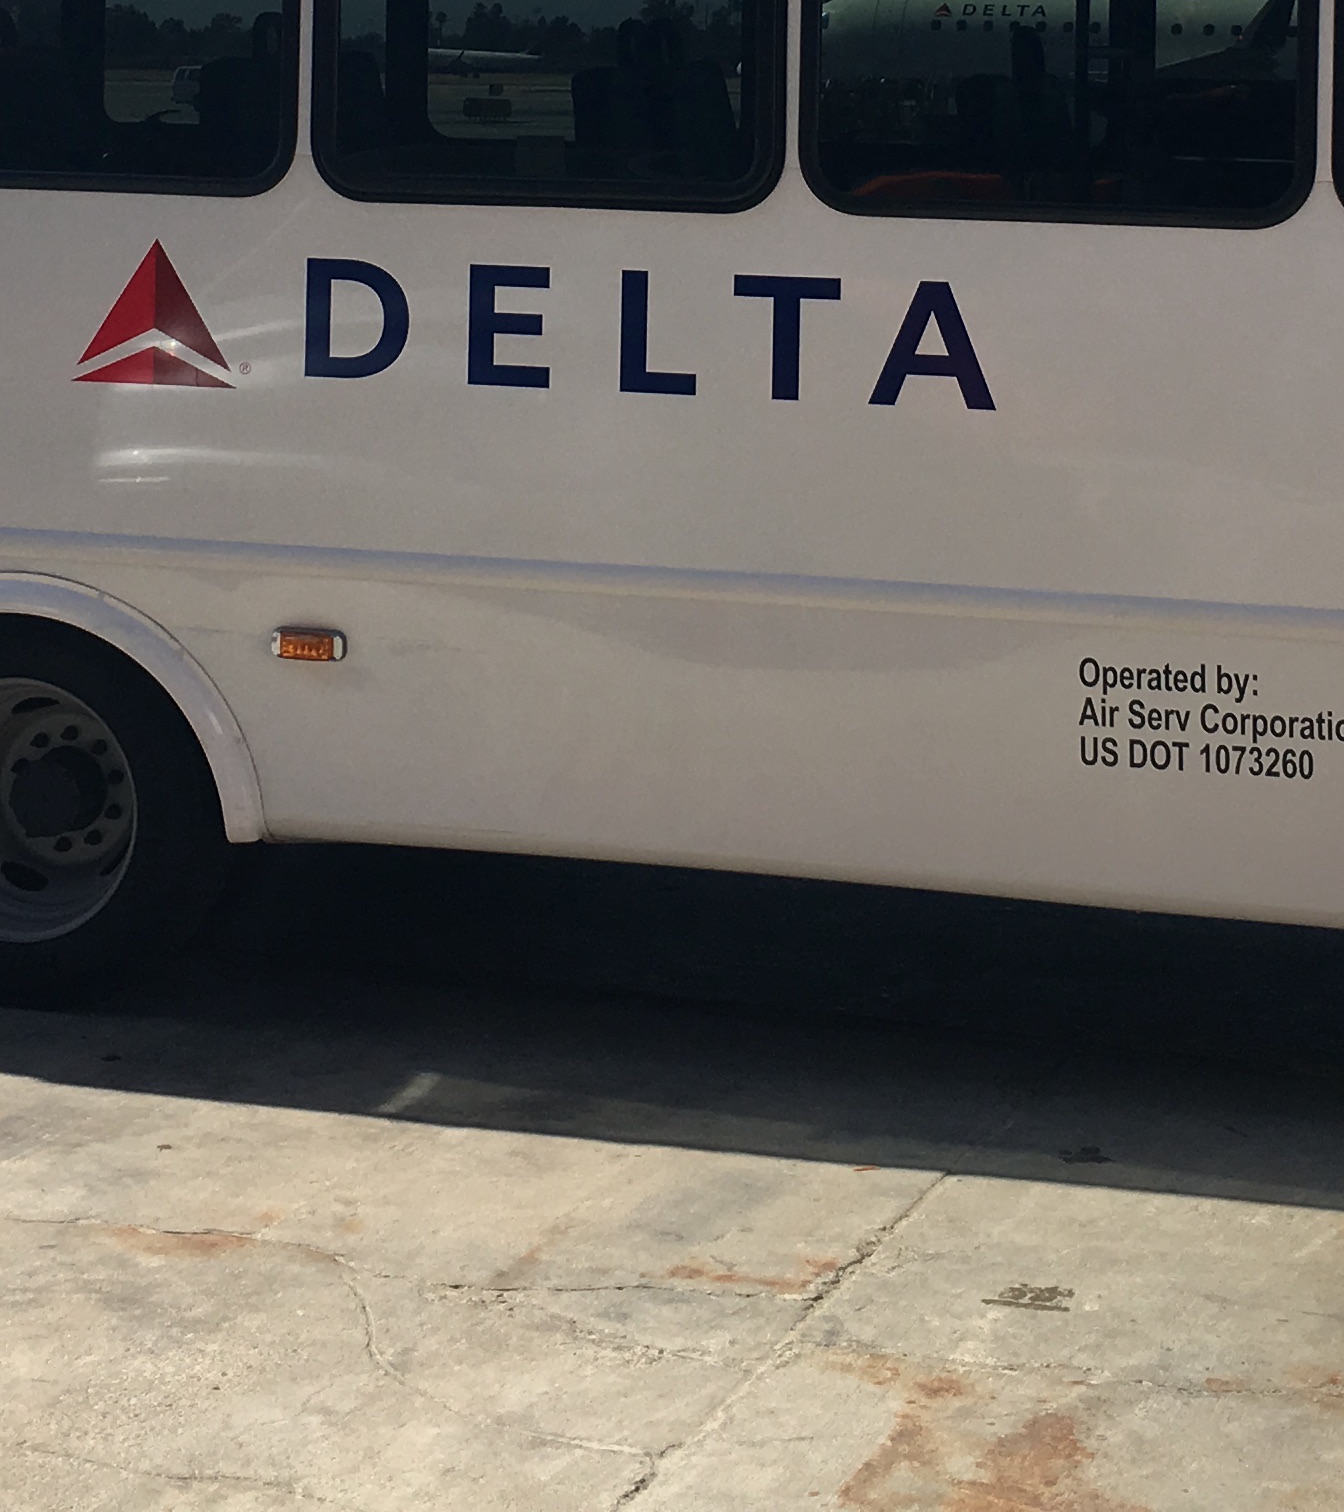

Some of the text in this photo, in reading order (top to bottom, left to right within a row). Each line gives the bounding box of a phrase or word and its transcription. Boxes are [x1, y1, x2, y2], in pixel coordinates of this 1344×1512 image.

[962, 3, 1046, 17] DELTA
[303, 256, 997, 411] DELTA
[1079, 657, 1258, 703] Operated by:
[1078, 696, 1119, 728] Air
[1128, 698, 1191, 732] Serv
[1080, 735, 1314, 780] US DOT 1073260
